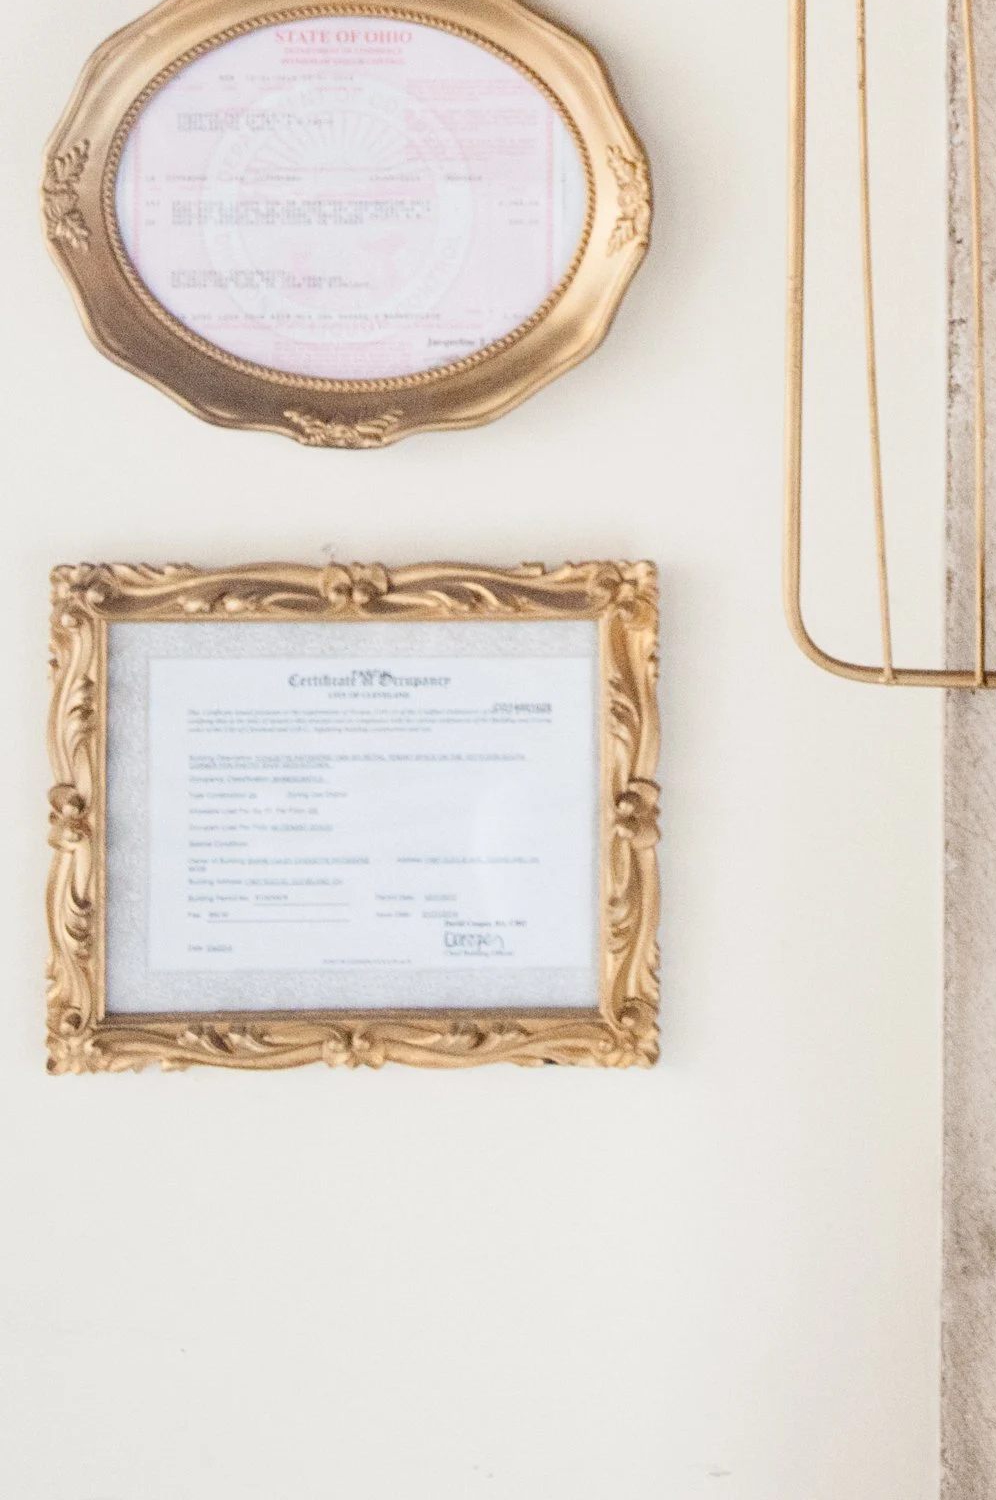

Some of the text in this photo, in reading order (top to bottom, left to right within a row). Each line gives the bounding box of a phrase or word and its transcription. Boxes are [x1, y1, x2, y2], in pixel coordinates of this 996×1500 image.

[275, 30, 414, 43] STATE OF OHIO
